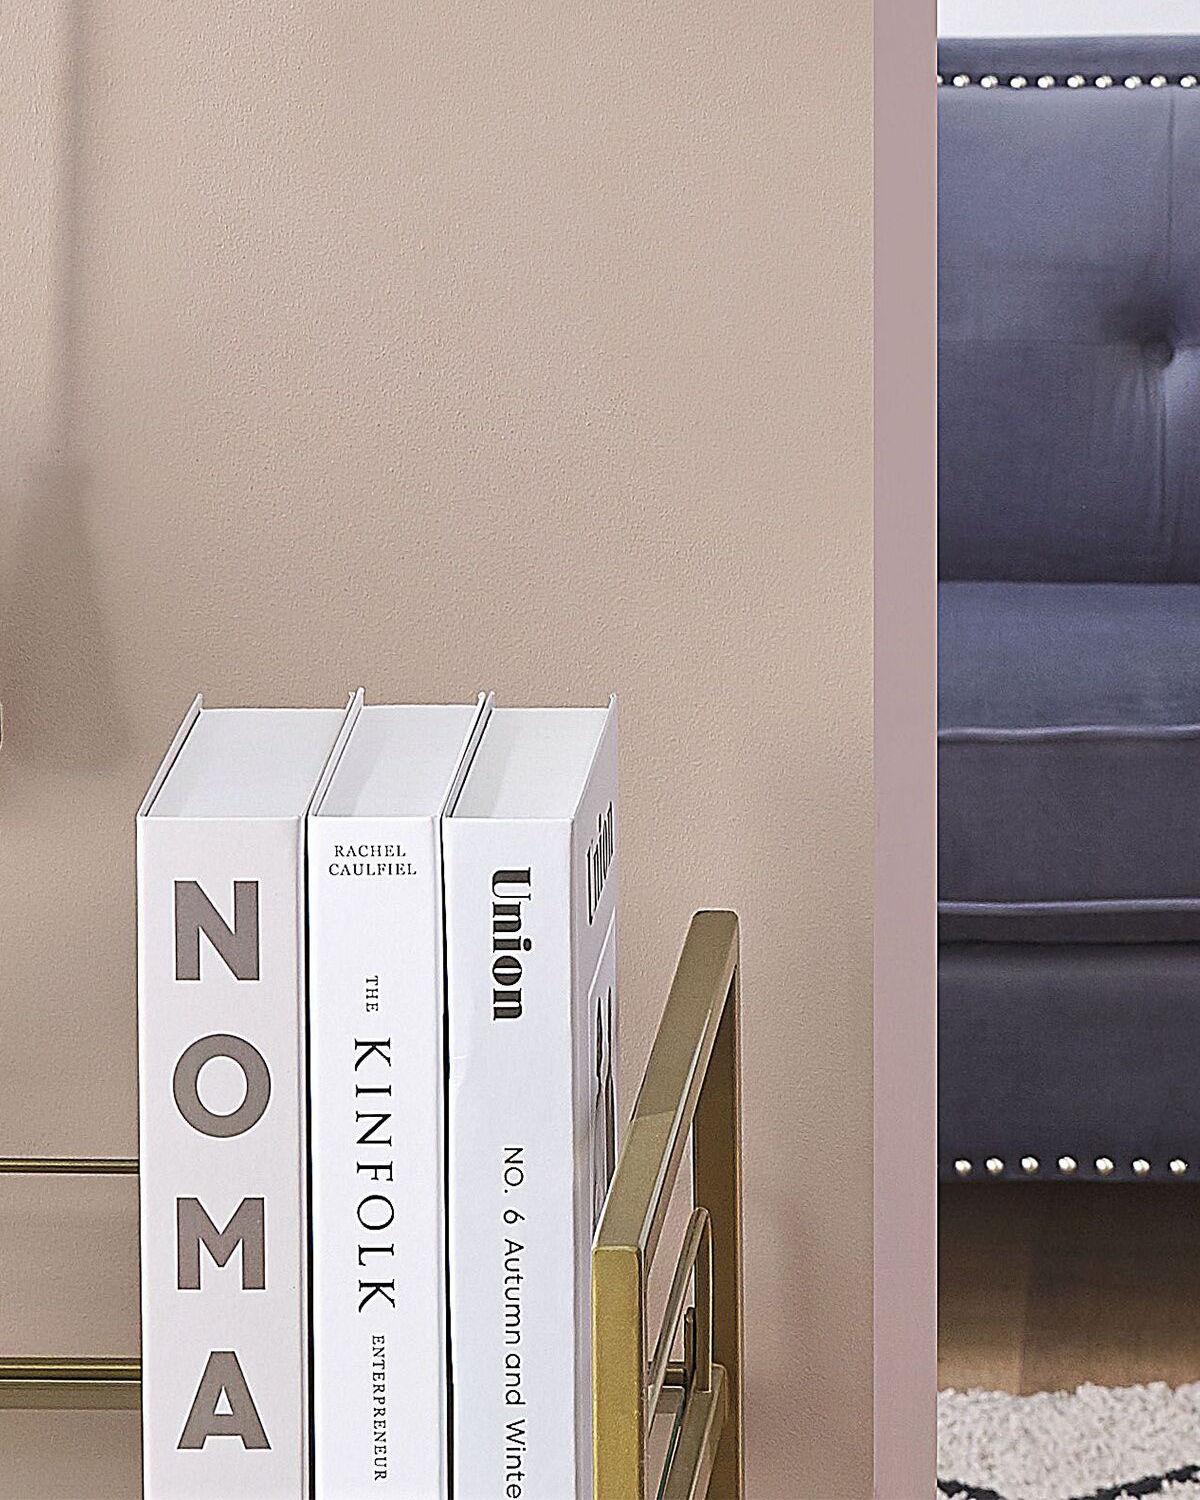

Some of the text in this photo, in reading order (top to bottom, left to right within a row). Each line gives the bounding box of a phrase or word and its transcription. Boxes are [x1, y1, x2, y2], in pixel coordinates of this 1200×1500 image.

[328, 863, 417, 876] CAULFIEL
[334, 844, 406, 858] RACHEL
[491, 866, 532, 1022] Union
[173, 880, 272, 1451] NOMA
[503, 1147, 525, 1194] NO.
[354, 975, 396, 1482] THE KINFOLK ENTERPRENEUR
[502, 1209, 526, 1225] 6
[504, 1238, 525, 1345] Autumn
[505, 1353, 527, 1405] and
